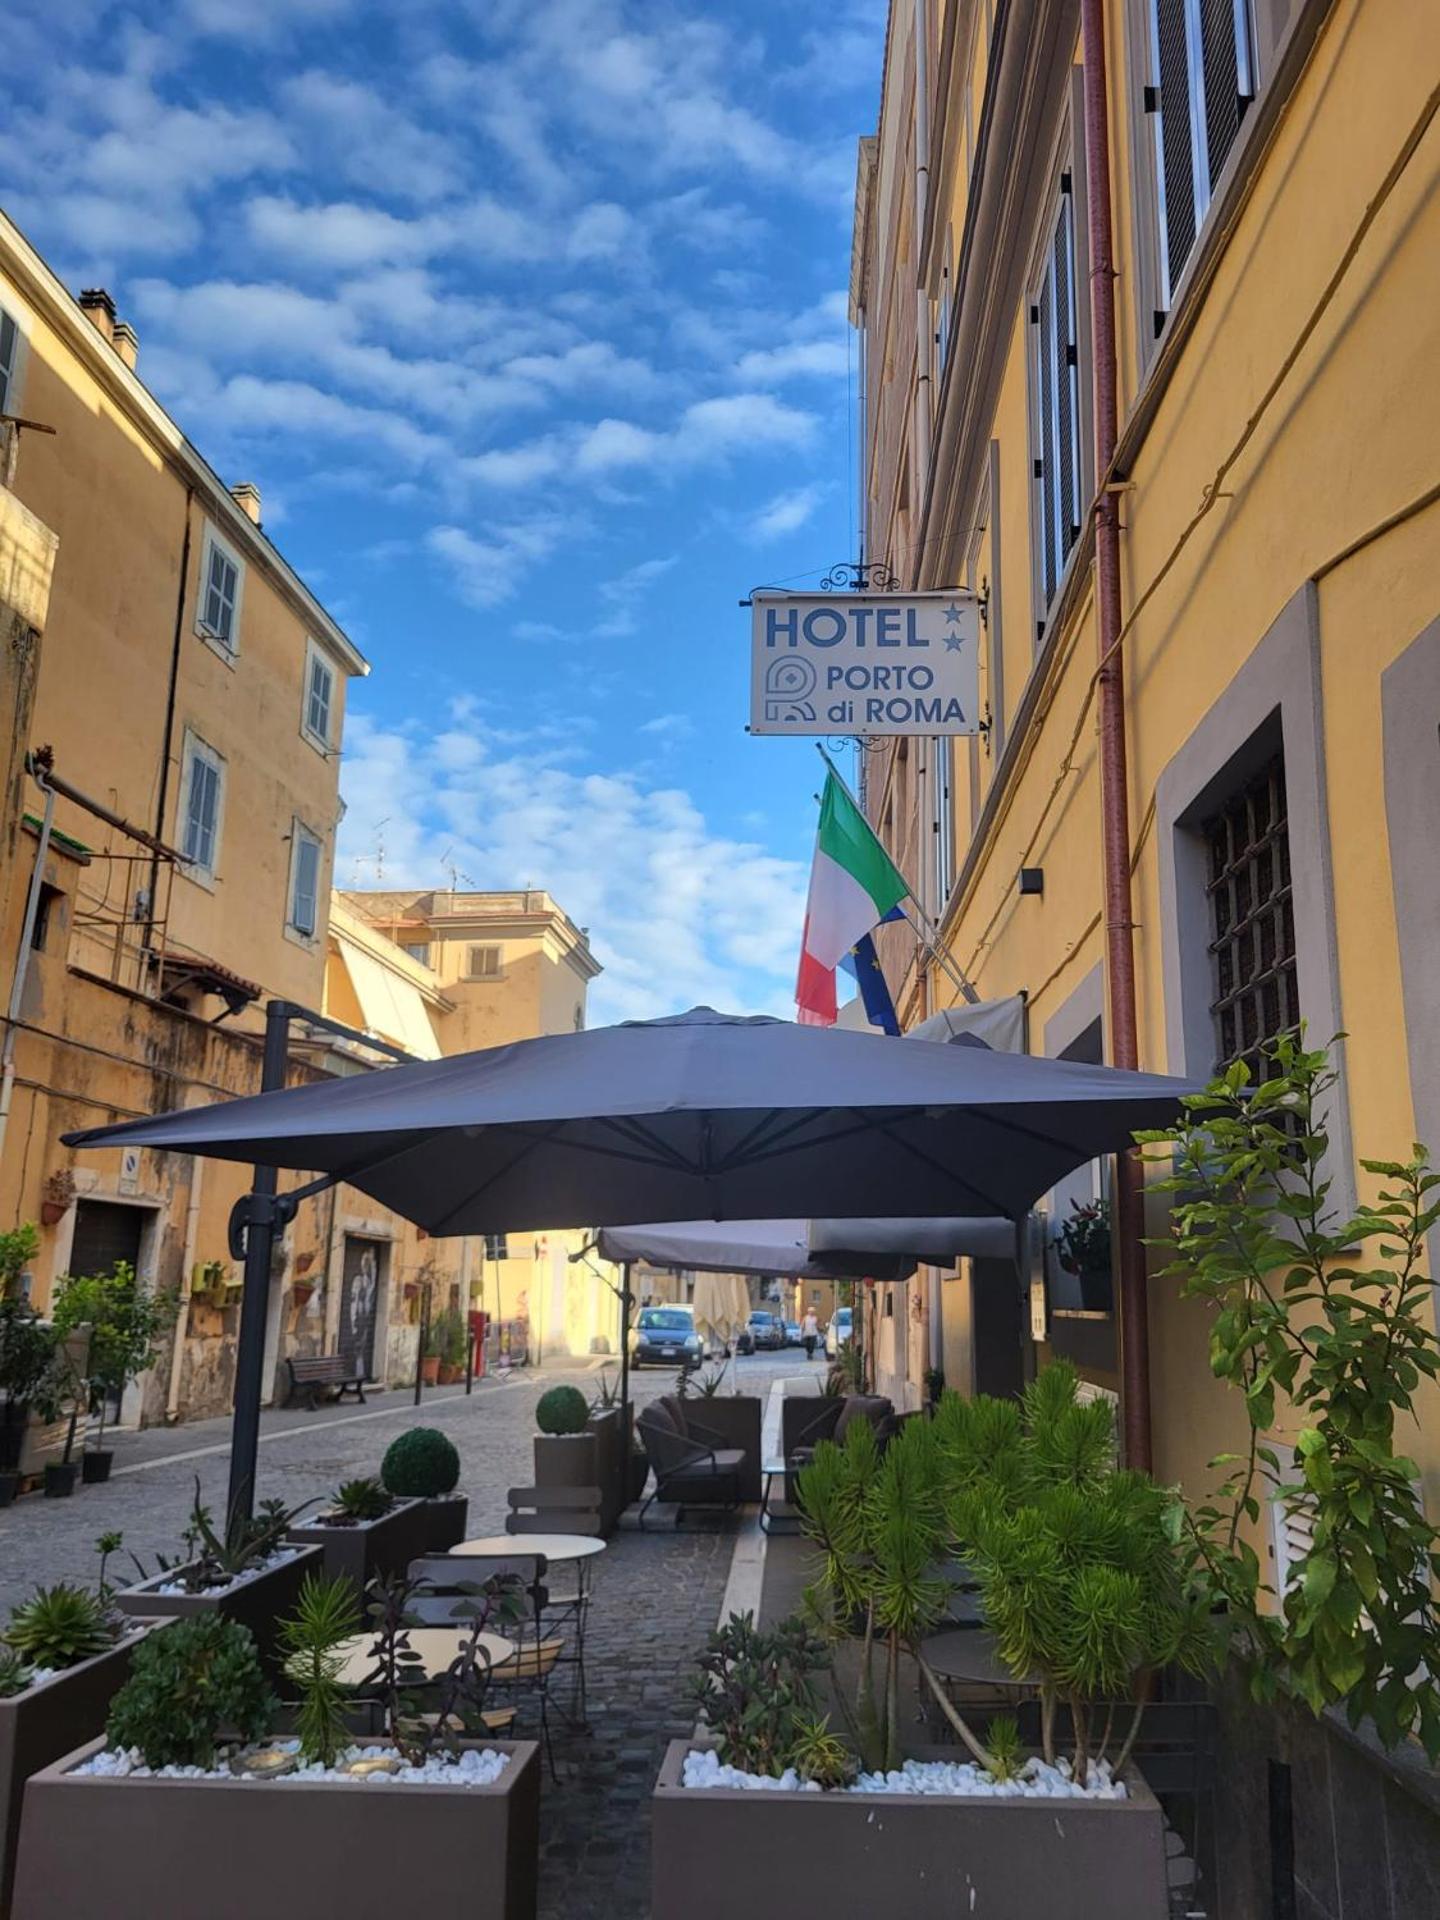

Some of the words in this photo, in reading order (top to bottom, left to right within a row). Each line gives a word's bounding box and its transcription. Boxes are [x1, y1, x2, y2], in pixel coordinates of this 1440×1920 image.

[766, 608, 929, 647] HOTEL
[827, 665, 934, 691] PORTO
[828, 701, 853, 723] di
[866, 697, 965, 723] ROMA
